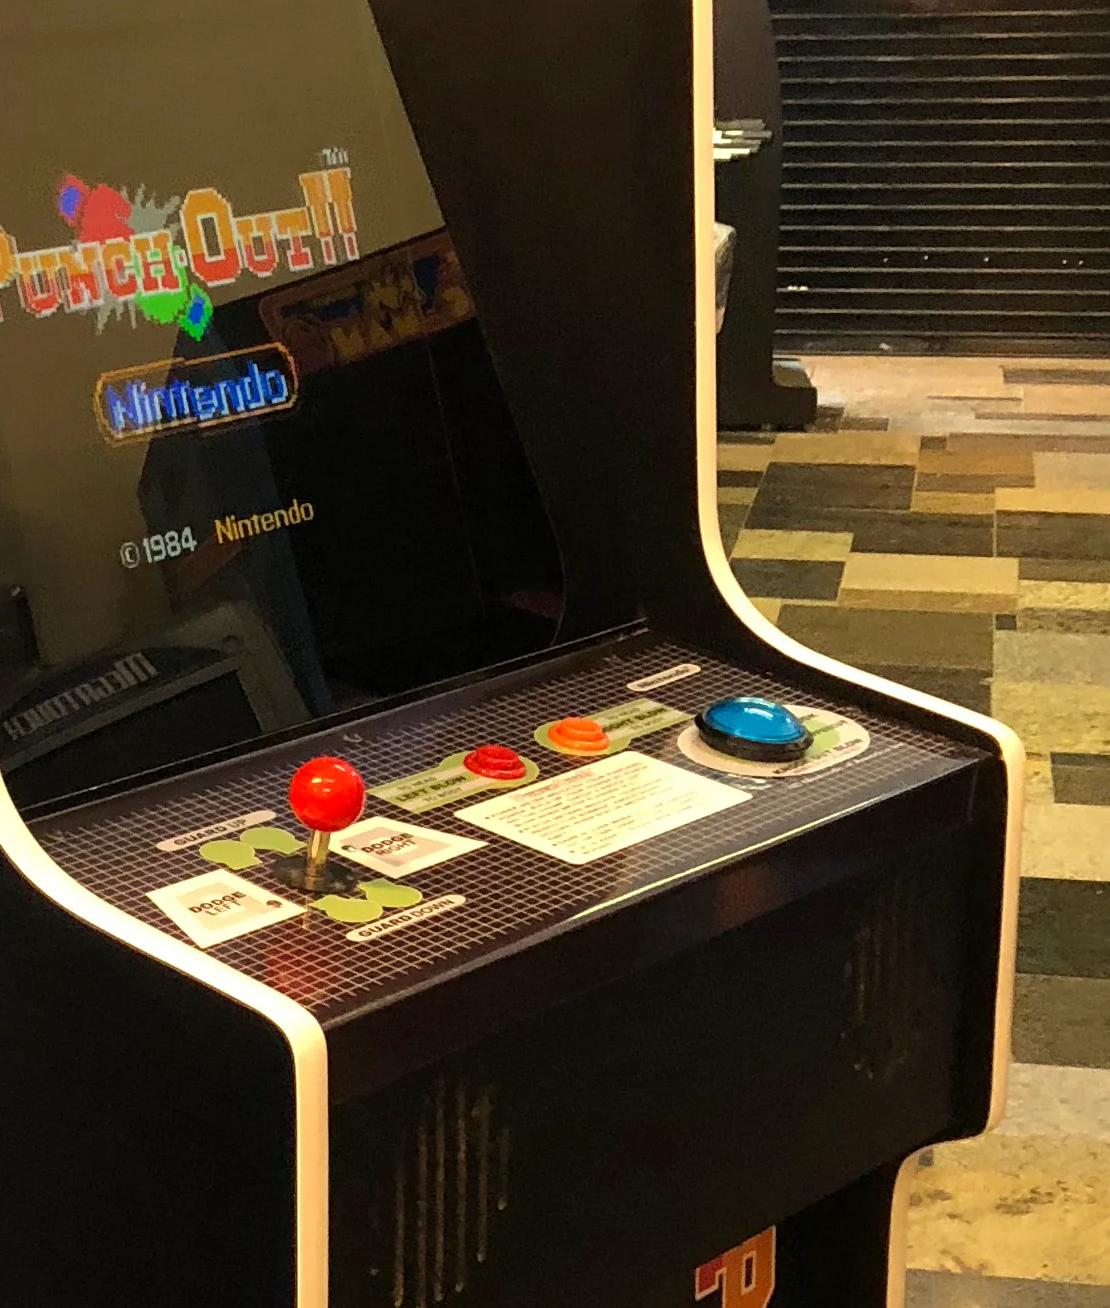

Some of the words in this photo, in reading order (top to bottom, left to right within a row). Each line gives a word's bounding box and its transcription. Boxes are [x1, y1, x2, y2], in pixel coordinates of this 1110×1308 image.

[104, 361, 290, 436] Nintendo
[214, 498, 315, 544] Nintendo
[173, 825, 228, 846] GUARD
[228, 818, 248, 829] UP
[361, 832, 414, 854] DODGE
[375, 841, 417, 856] RIGHT
[188, 890, 247, 914] DODGE
[204, 900, 242, 917] LEFT
[358, 913, 413, 938] GUARD
[412, 898, 456, 919] DOWN
